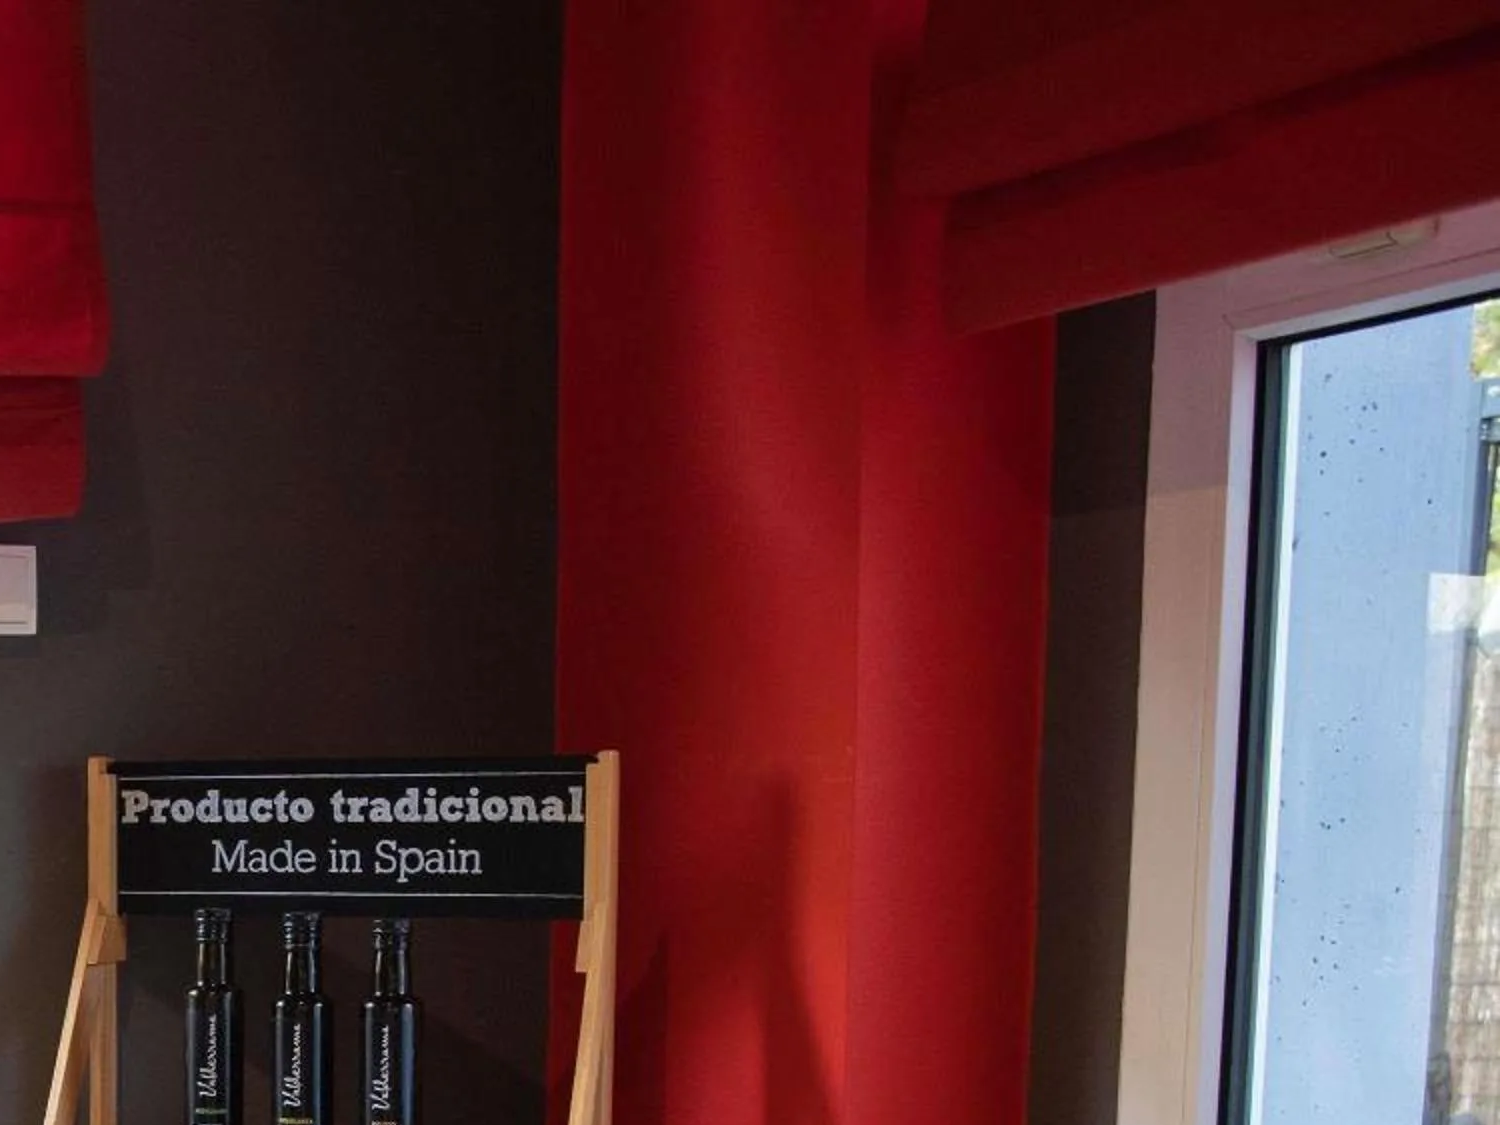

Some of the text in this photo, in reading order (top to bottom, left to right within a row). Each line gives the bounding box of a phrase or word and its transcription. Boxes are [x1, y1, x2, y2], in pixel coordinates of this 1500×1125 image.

[121, 786, 585, 824] Producto tradicional
[211, 839, 483, 883] Made in Spain
